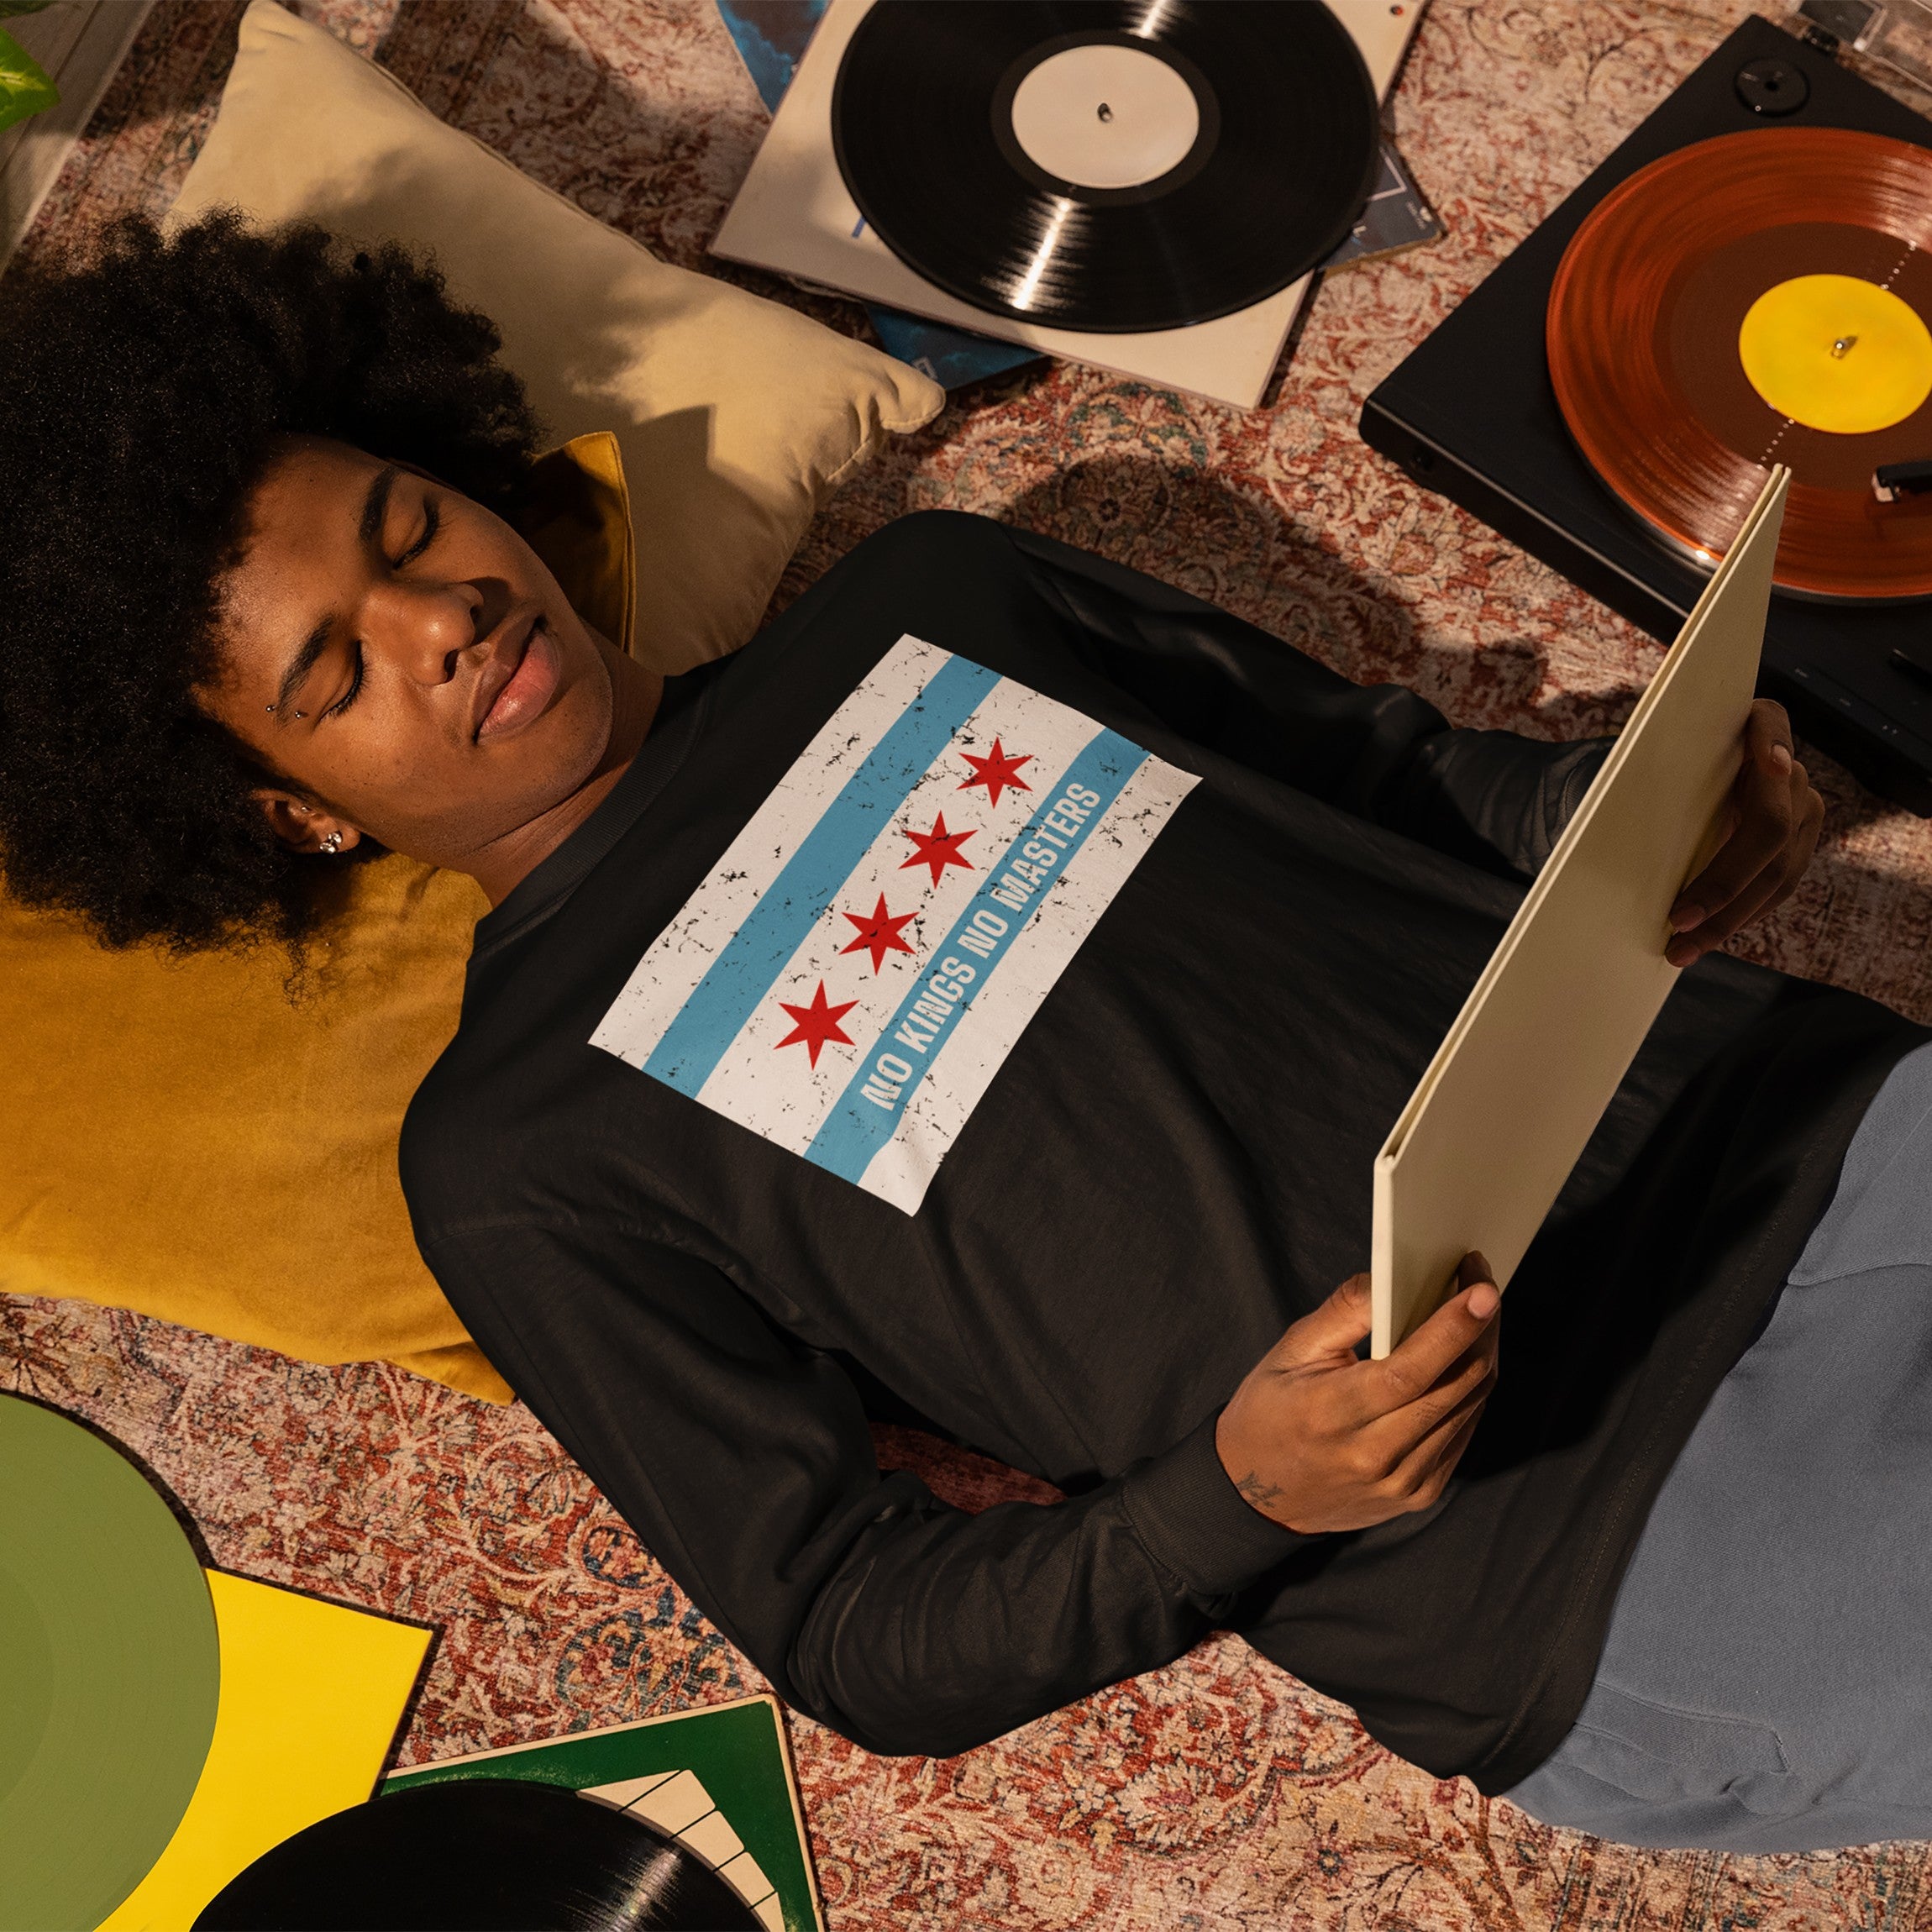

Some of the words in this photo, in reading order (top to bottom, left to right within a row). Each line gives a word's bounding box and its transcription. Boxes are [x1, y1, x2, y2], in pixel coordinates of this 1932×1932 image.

[860, 1052, 913, 1110] NO
[895, 955, 977, 1053] KINGS
[958, 909, 1008, 959] NO
[990, 782, 1100, 911] MASTERS
